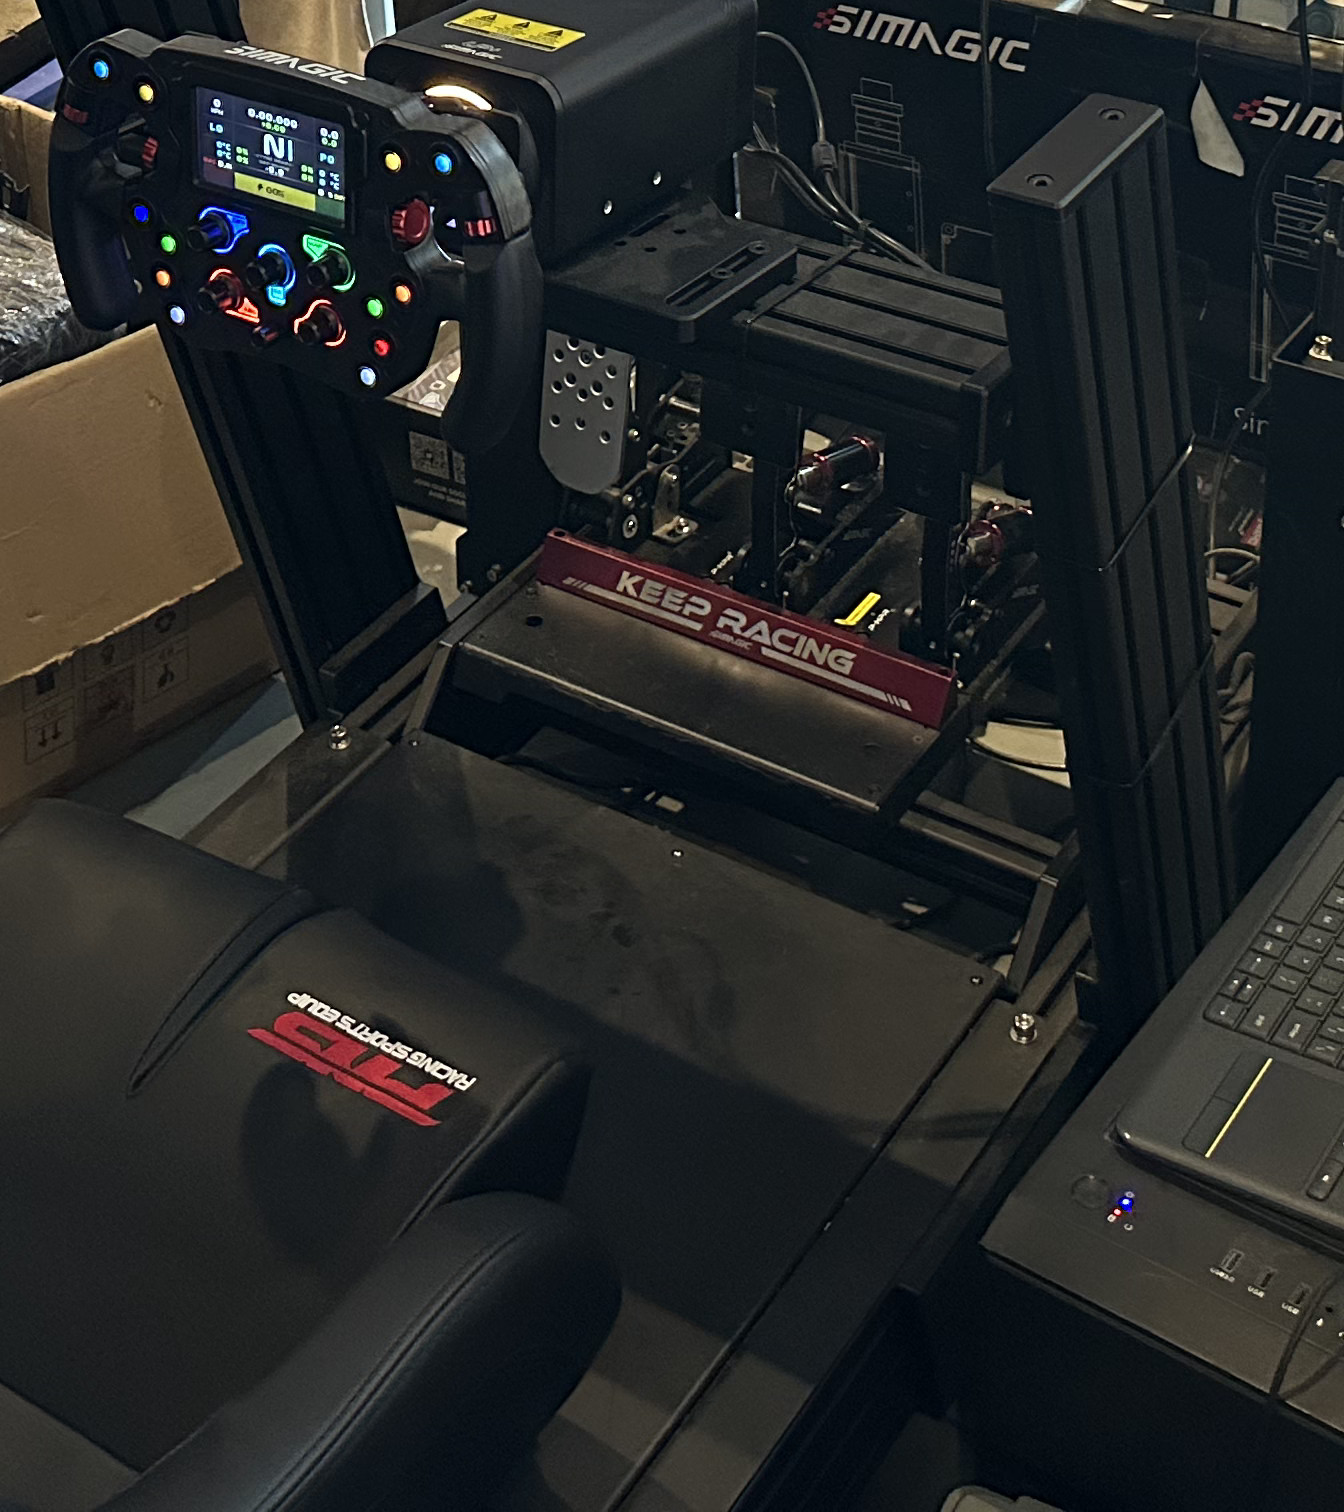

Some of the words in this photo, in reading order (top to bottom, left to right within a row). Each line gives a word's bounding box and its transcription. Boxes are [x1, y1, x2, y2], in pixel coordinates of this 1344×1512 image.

[814, 4, 1032, 75] SIMAGIC
[223, 44, 367, 87] SIMAGIC
[615, 569, 713, 619] KEEP
[716, 608, 858, 677] RACING
[286, 991, 342, 1025] EQUIP
[335, 1014, 412, 1062] SPORTS
[408, 1050, 477, 1092] RACING
